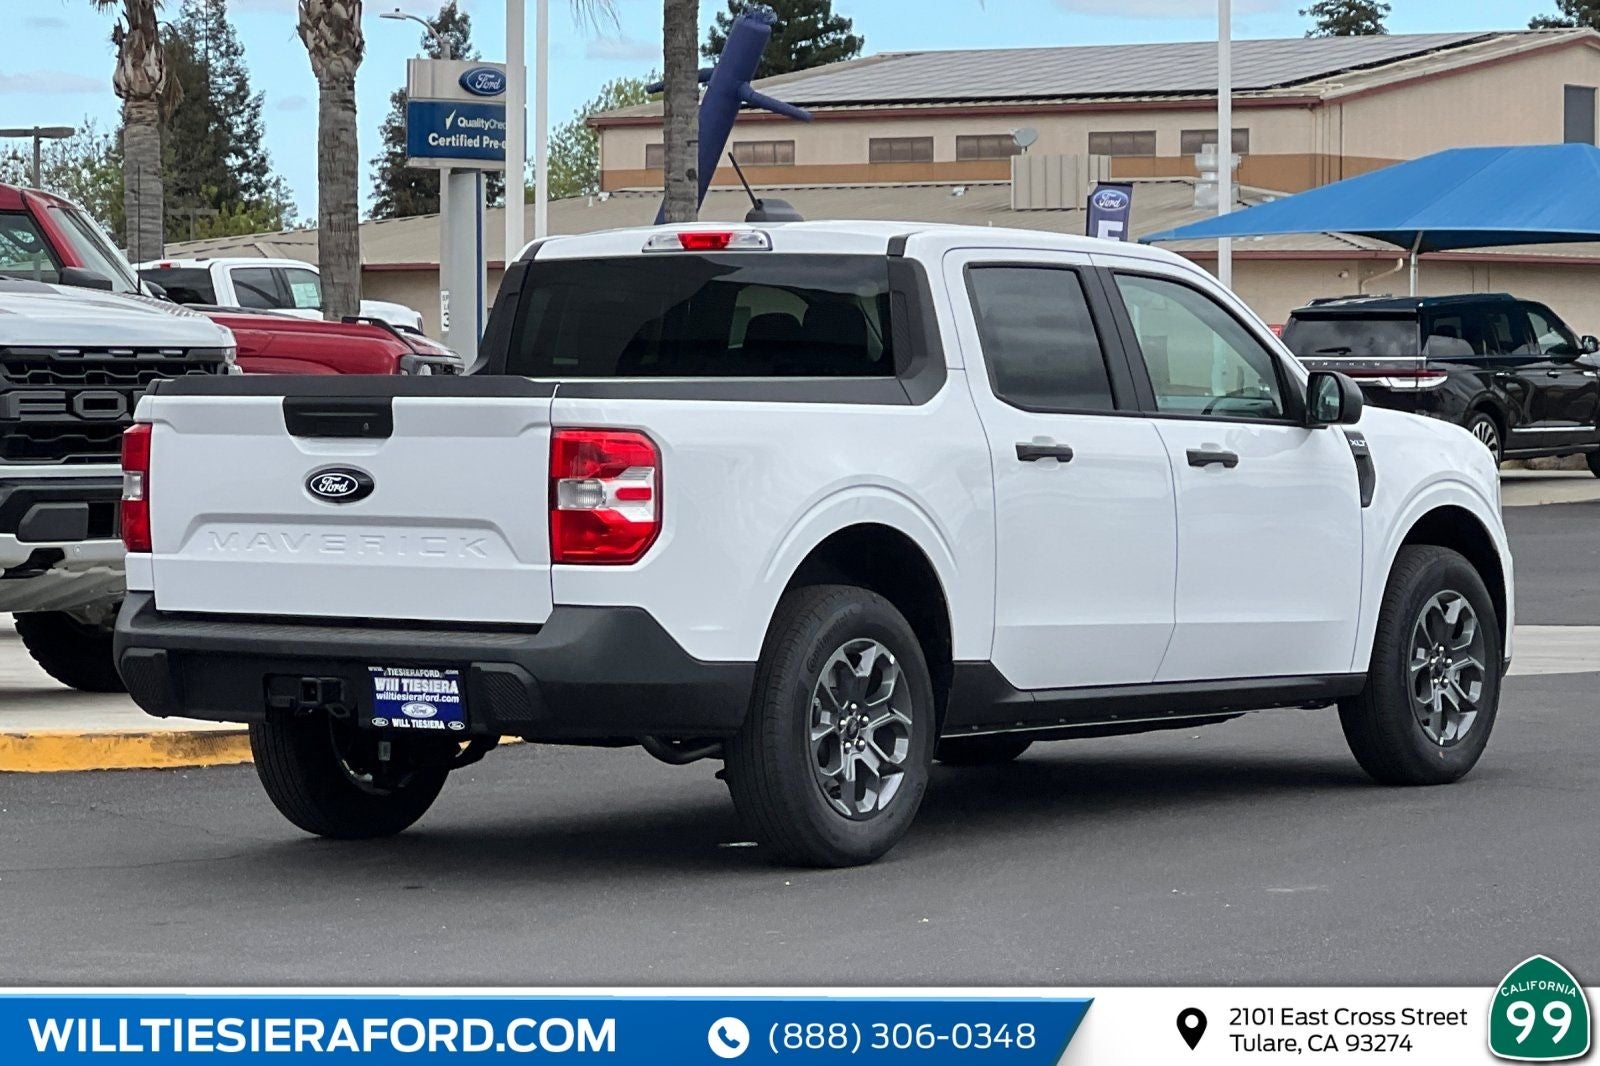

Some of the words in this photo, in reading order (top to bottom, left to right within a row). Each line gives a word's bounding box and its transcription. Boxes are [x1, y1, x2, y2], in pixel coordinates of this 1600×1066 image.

[475, 73, 501, 90] Ford
[428, 132, 480, 148] Certified
[1099, 192, 1122, 208] Ford
[1349, 439, 1367, 447] XLT
[318, 476, 349, 494] Ford
[207, 530, 489, 559] MAVERICK
[401, 678, 459, 694] TIESIERA
[376, 692, 460, 703] willtiesieraford.com
[391, 718, 410, 727] WILL
[411, 719, 445, 729] TIESIERA
